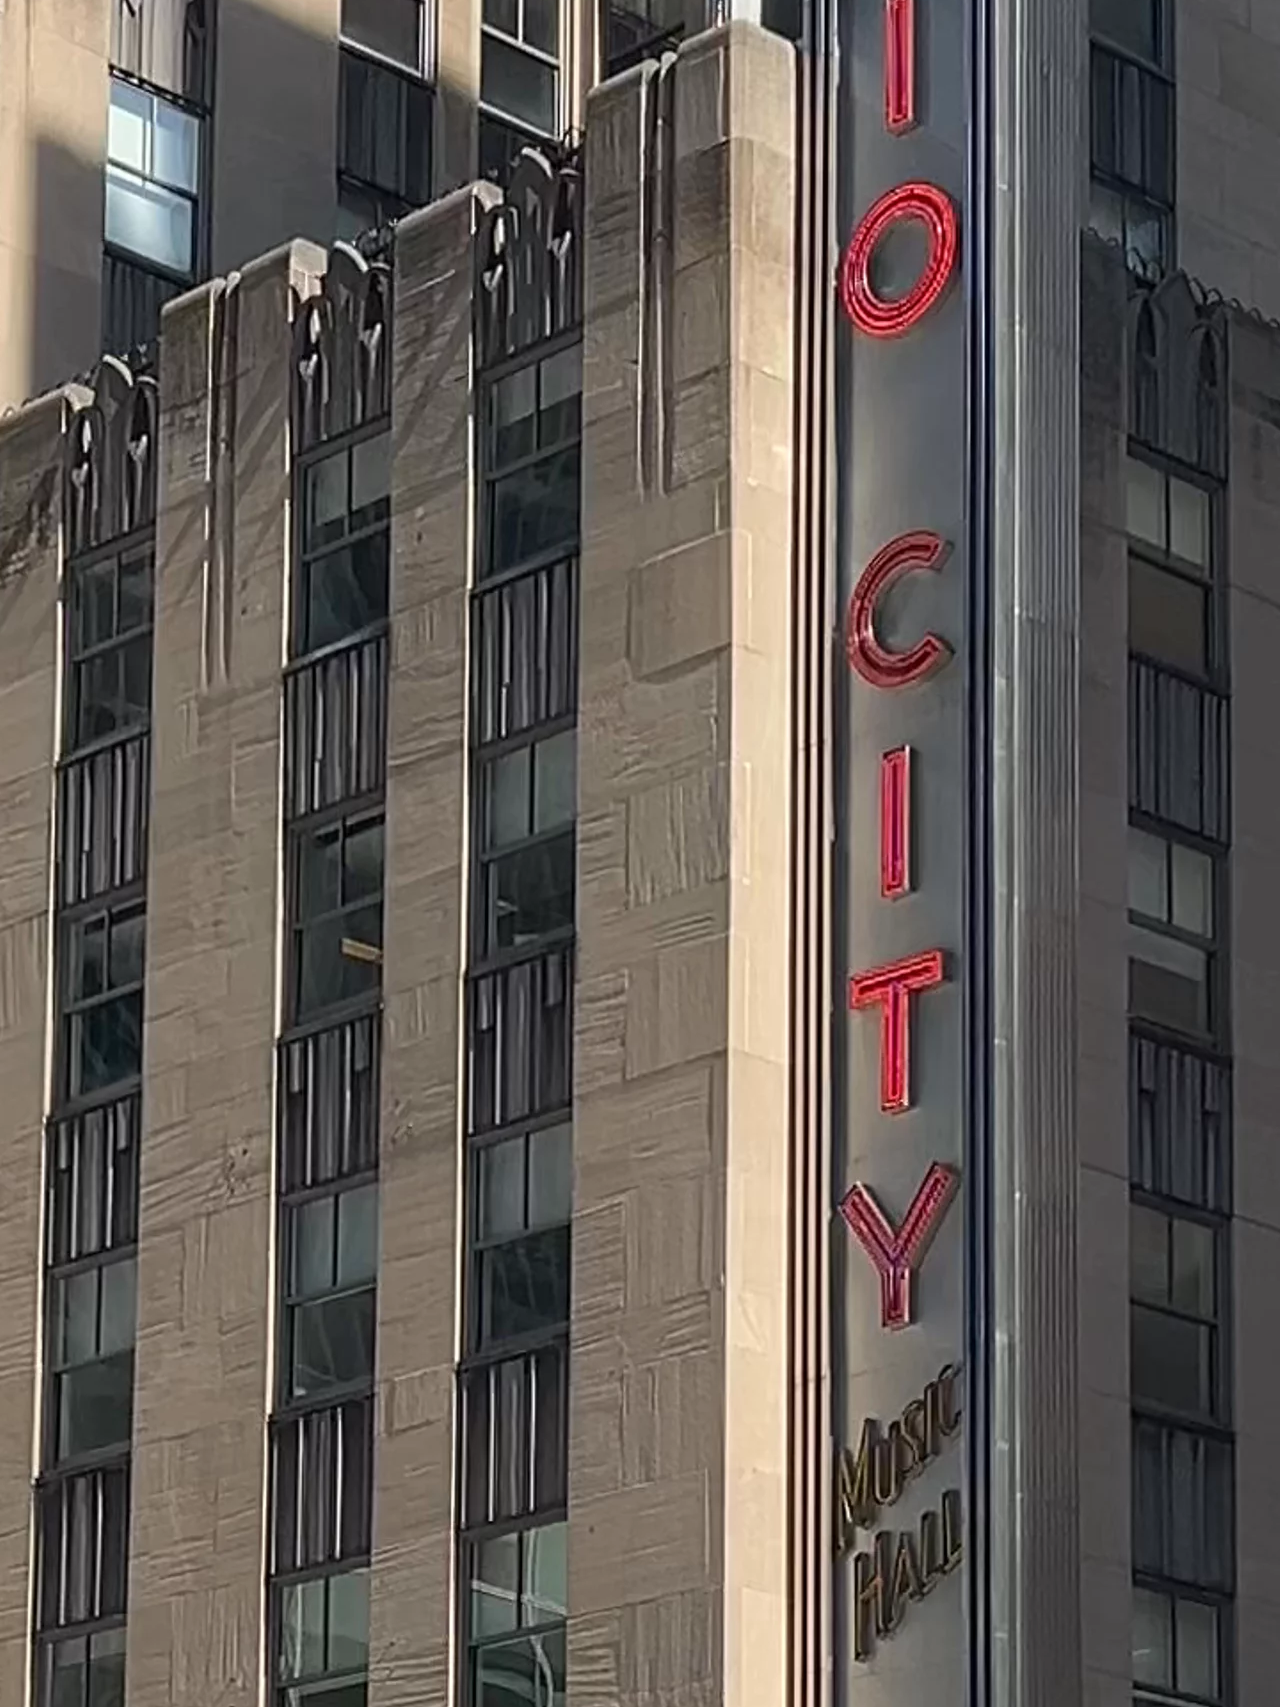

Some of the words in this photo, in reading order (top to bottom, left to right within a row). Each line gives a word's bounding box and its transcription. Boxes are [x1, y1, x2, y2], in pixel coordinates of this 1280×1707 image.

[839, 529, 957, 1331] CITY
[835, 1363, 964, 1551] MUSIC
[853, 1488, 963, 1663] HALL
